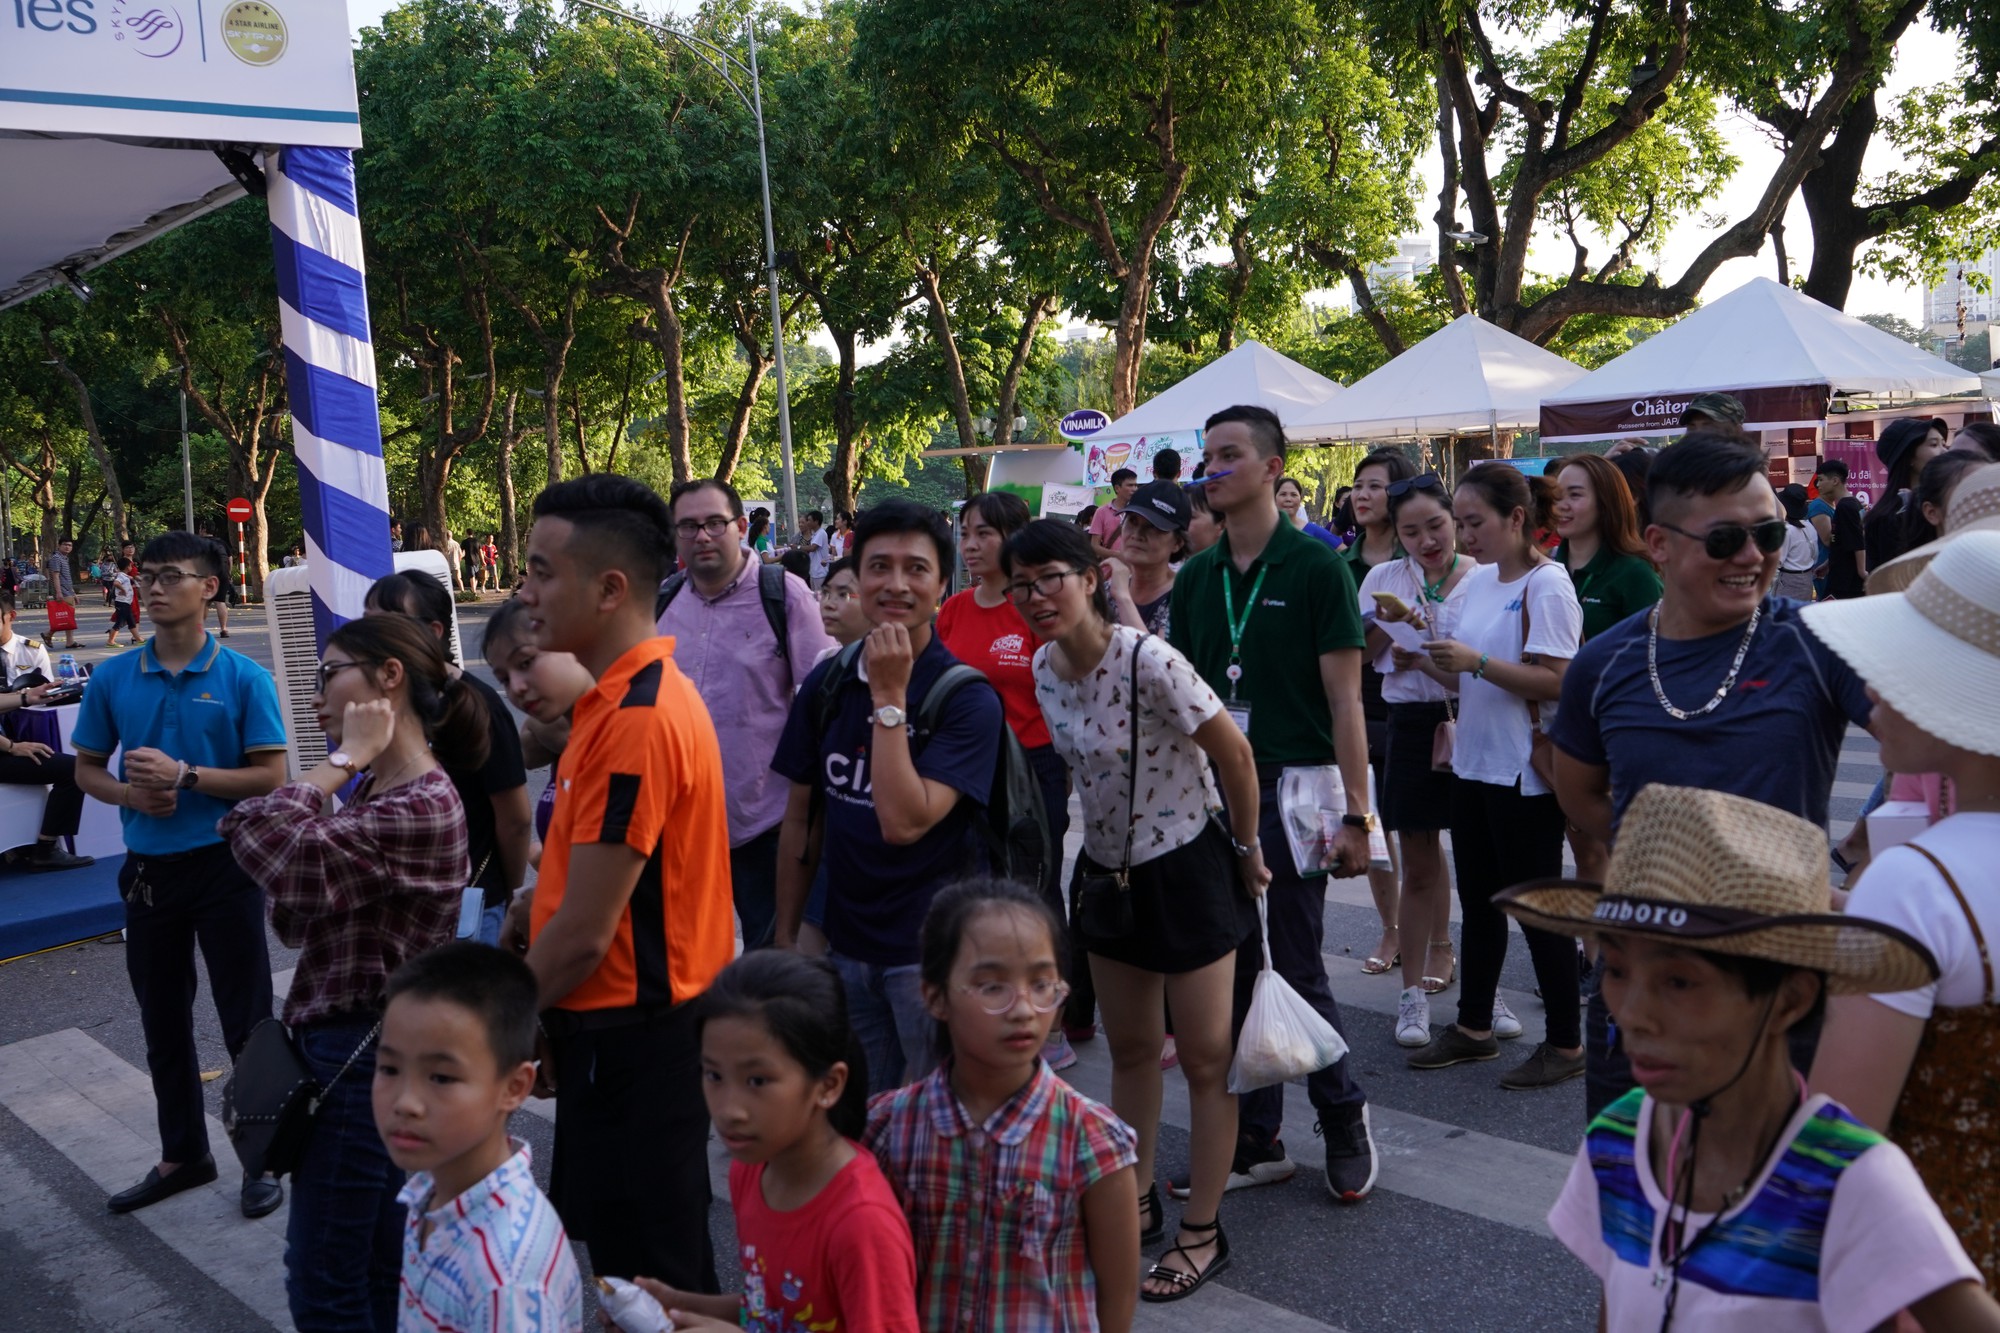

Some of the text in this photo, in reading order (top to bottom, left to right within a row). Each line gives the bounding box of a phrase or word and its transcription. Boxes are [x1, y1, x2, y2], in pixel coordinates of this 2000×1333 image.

[13, 0, 98, 34] es
[254, 22, 279, 30] AIRLINE
[226, 30, 284, 41] SKYTRAX
[1063, 418, 1105, 431] VINAMILK
[1617, 422, 1646, 430] Patisserie
[1661, 417, 1680, 426] JAP
